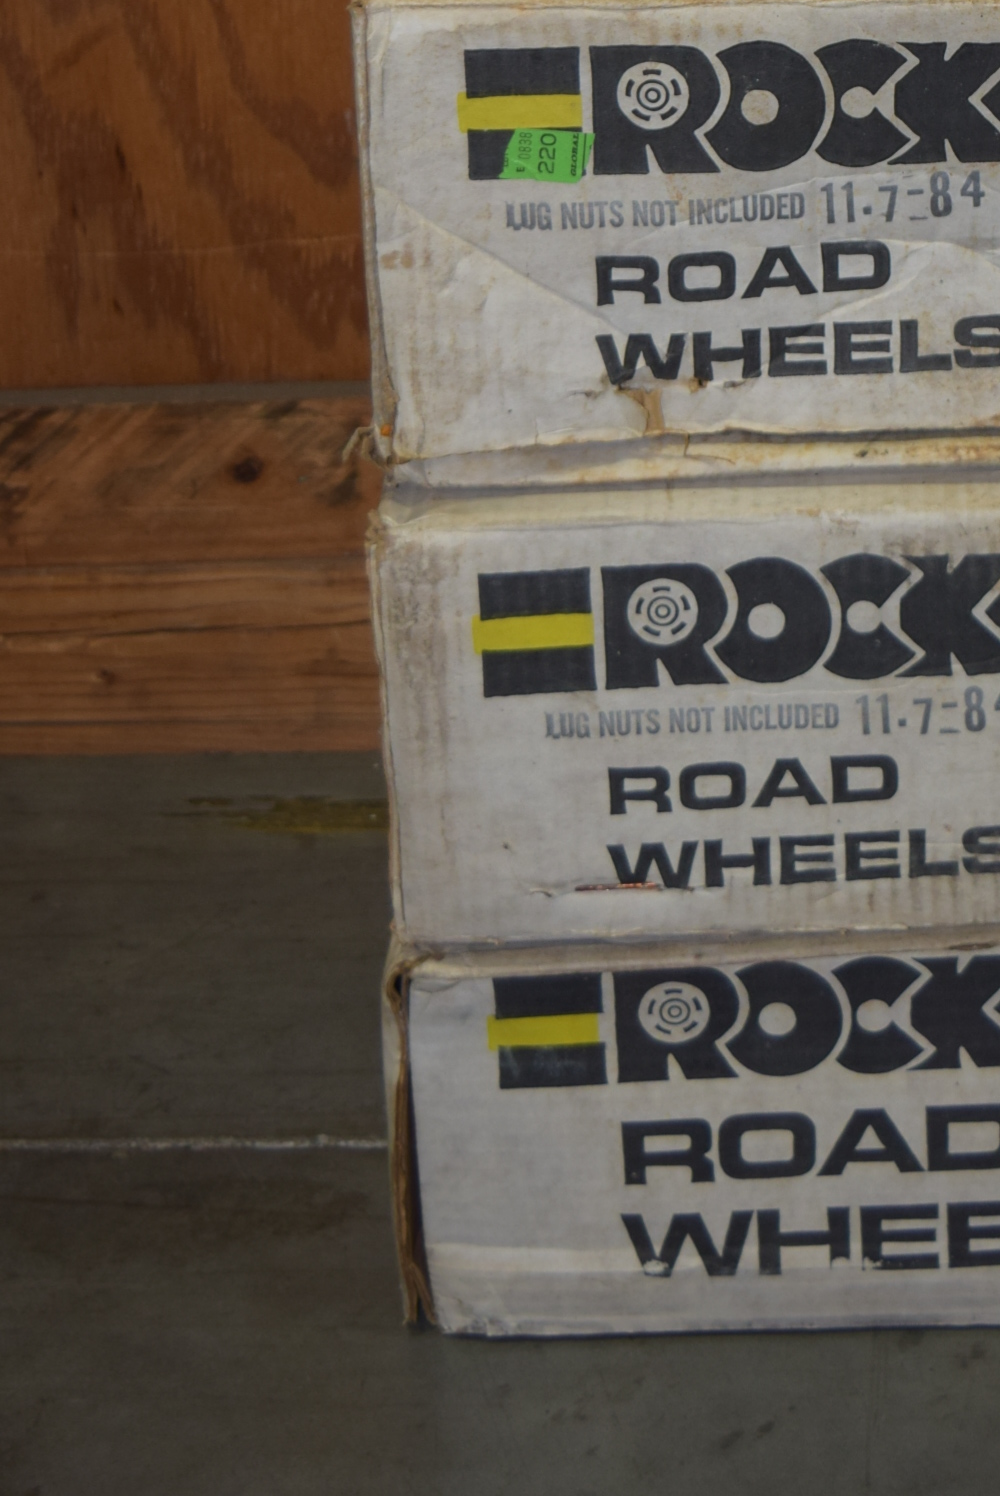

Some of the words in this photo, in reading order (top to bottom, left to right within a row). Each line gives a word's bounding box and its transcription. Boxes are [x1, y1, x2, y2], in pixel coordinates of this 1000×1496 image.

[538, 133, 557, 174] 220
[570, 133, 579, 176] GLOBAL
[505, 200, 553, 231] LUG
[561, 200, 624, 229] NUTS
[632, 199, 678, 227] NOT
[688, 192, 805, 224] INCLUDED
[596, 240, 891, 306] ROAD
[545, 711, 591, 739] LUG
[598, 708, 661, 737] NUTS
[668, 707, 715, 735] NOT
[723, 701, 840, 731] INCLUDED
[607, 754, 899, 815] ROAD
